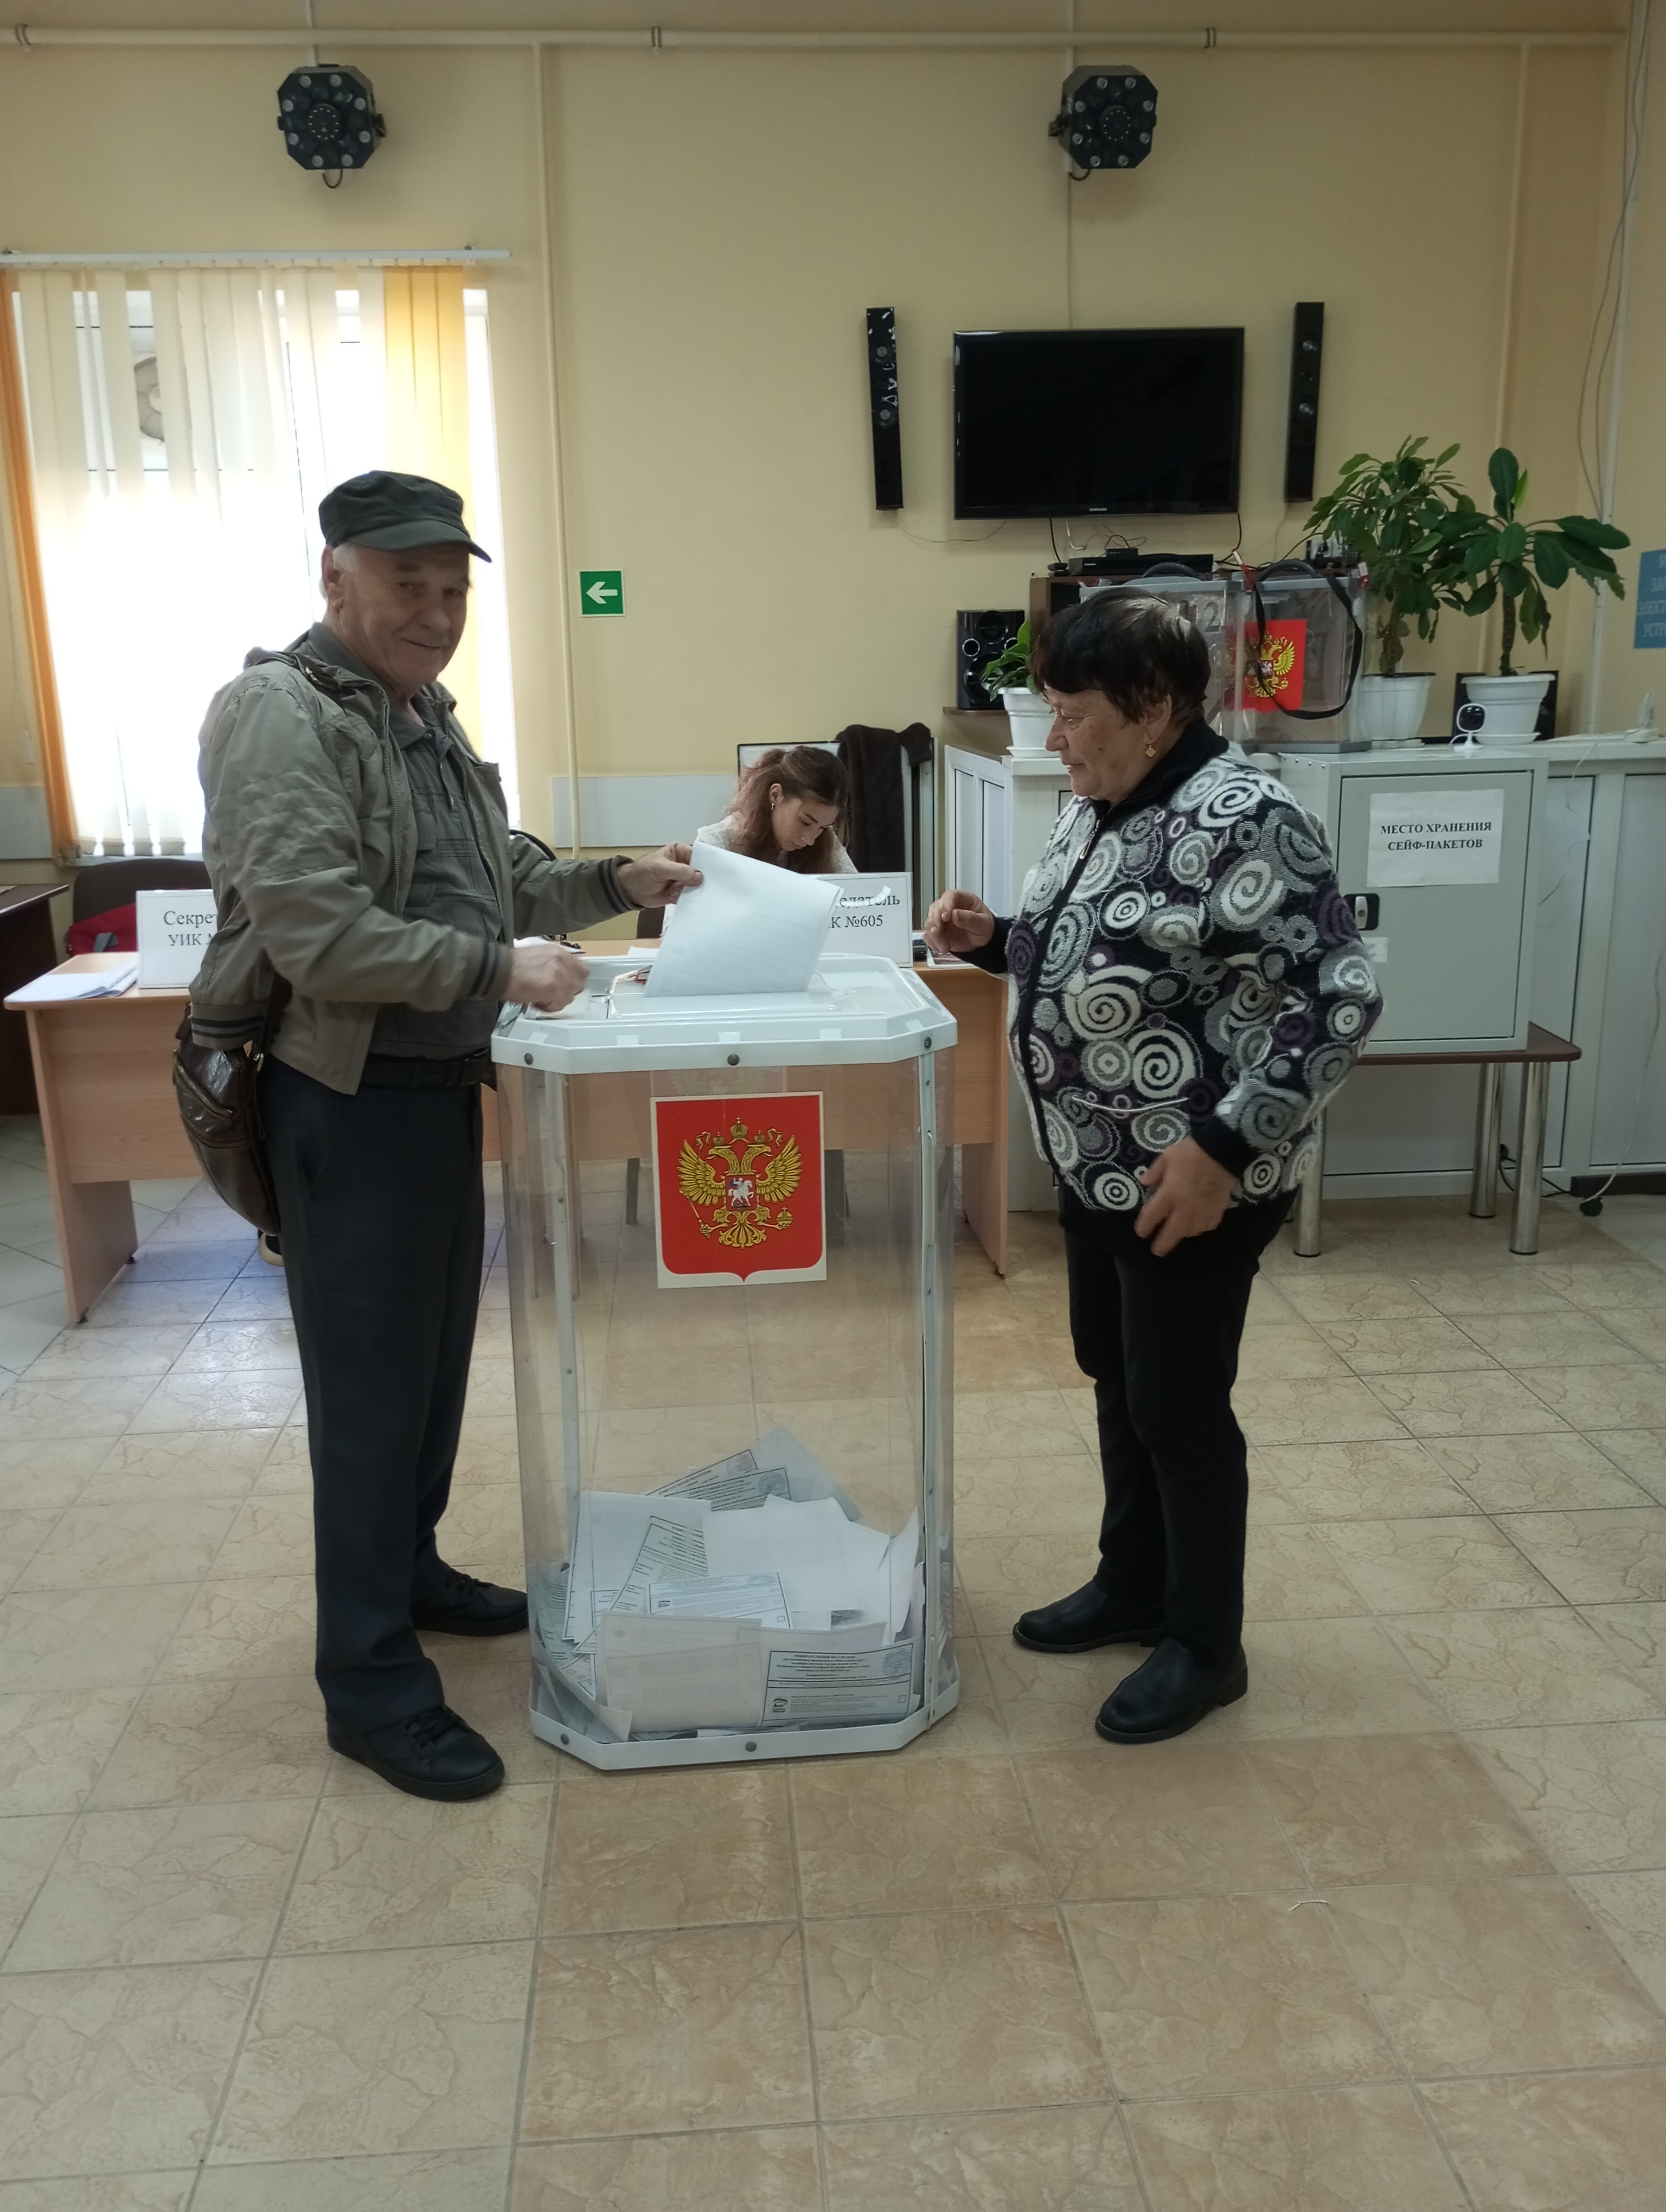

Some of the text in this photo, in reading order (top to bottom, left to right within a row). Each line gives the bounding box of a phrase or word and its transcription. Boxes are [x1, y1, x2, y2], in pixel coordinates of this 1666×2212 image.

[1381, 821, 1492, 834] МЕСТО ХРАНЕНИЯ
[1387, 839, 1483, 851] СЕЙФ-ПАКЕТОВ
[164, 911, 217, 928] Секре
[844, 915, 883, 928] №605
[168, 933, 202, 946] УИК
